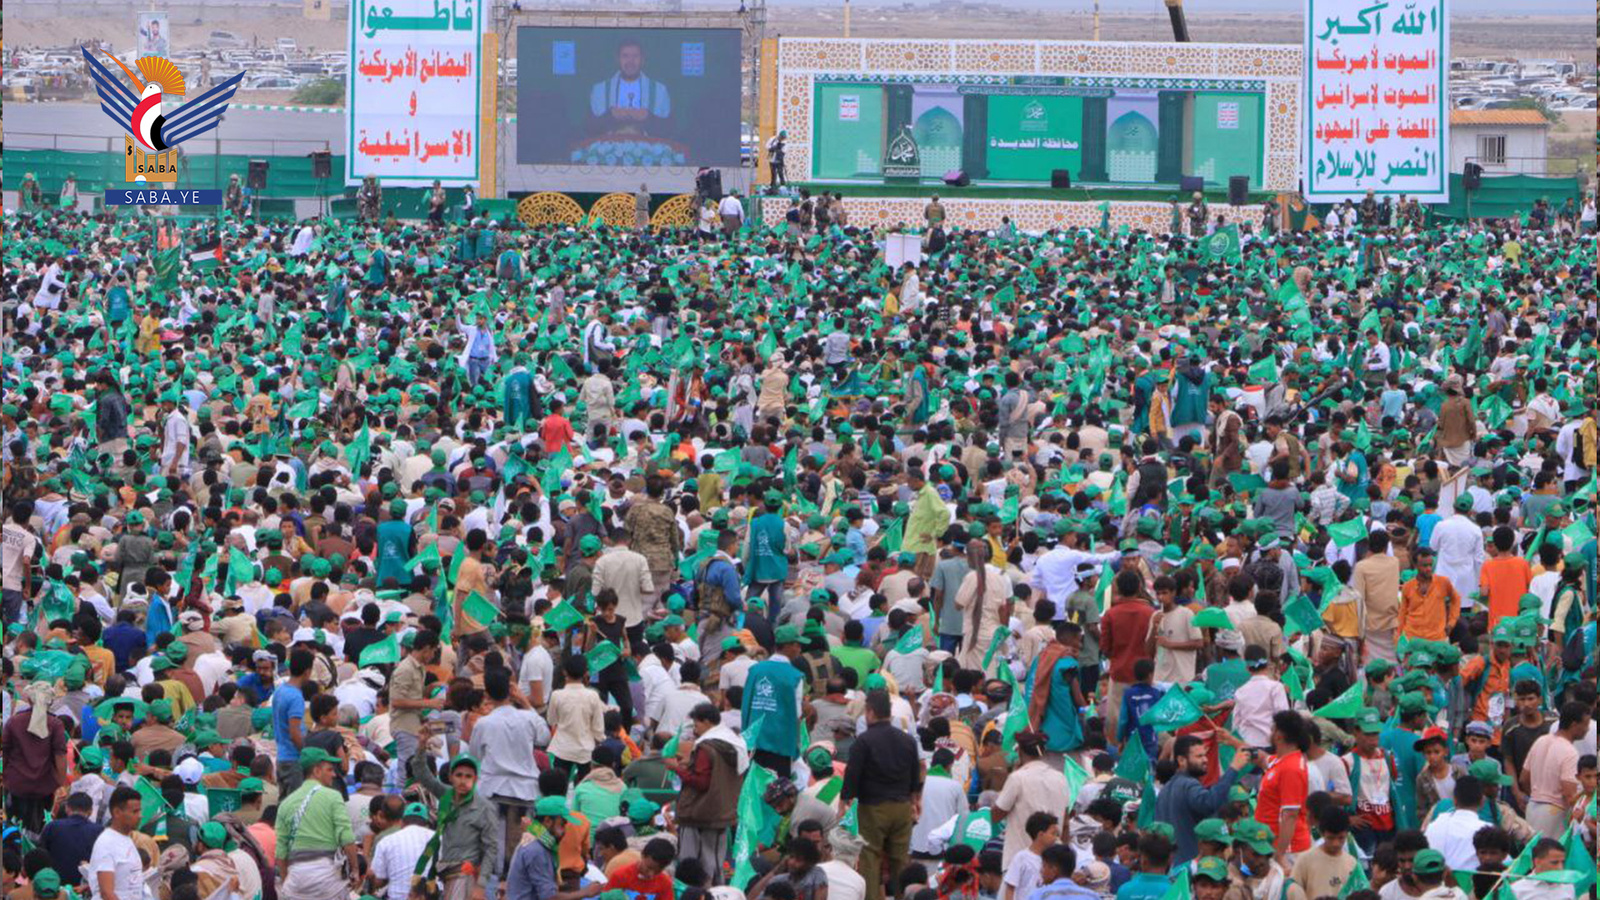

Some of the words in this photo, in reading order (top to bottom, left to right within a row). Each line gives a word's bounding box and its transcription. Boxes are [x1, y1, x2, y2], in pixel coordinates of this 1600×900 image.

[360, 0, 473, 38] قاطعوا
[1315, 0, 1388, 45] أكبر
[358, 44, 417, 84] الأمريكية
[420, 49, 471, 84] البضائع
[1317, 43, 1378, 75] لأمريكا
[1383, 49, 1436, 75] الموت
[409, 90, 417, 117] و
[1316, 83, 1378, 110] لإسرائيل
[1383, 84, 1436, 110] الموت
[1316, 118, 1360, 144] اليهود
[1366, 118, 1389, 144] على
[1396, 117, 1436, 139] اللعنة
[358, 128, 471, 163] الإسرائيلية
[990, 135, 1040, 151] الحديدة
[1042, 137, 1080, 150] محافظة
[1316, 149, 1377, 187] للإسلام
[1380, 146, 1436, 185] النصر
